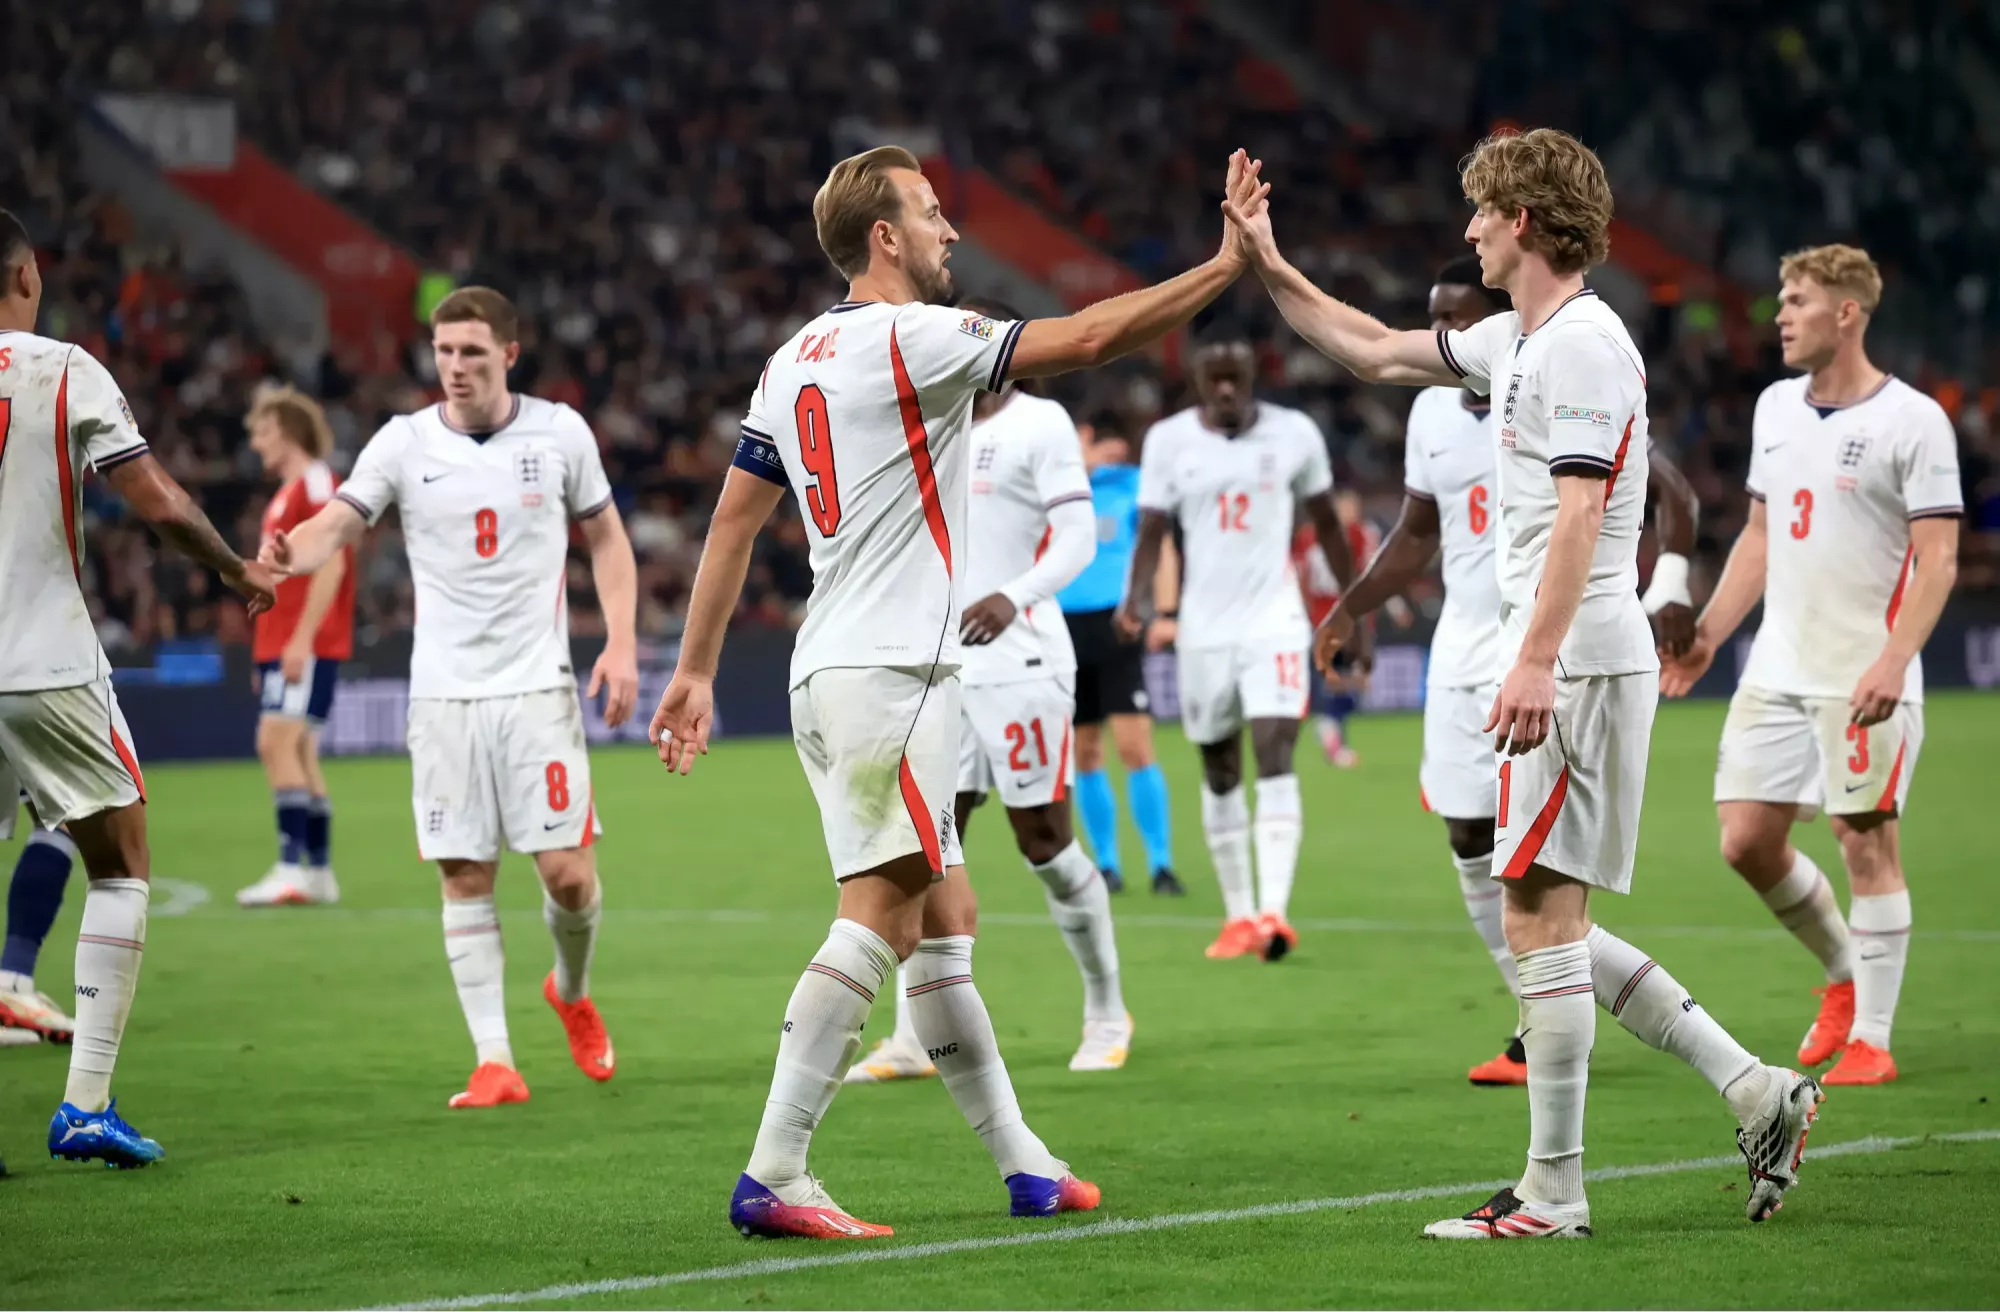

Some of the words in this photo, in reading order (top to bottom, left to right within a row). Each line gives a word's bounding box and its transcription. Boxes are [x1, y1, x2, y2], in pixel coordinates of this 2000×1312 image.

[1554, 409, 1611, 421] FOUNDATION
[794, 383, 842, 538] 9
[475, 507, 498, 558] 8
[1218, 494, 1252, 531] 12
[1468, 485, 1487, 535] 6
[1790, 488, 1813, 540] 3
[1004, 717, 1048, 771] 21
[1846, 722, 1869, 774] 3
[545, 761, 569, 812] 8
[928, 1042, 958, 1061] ENG
